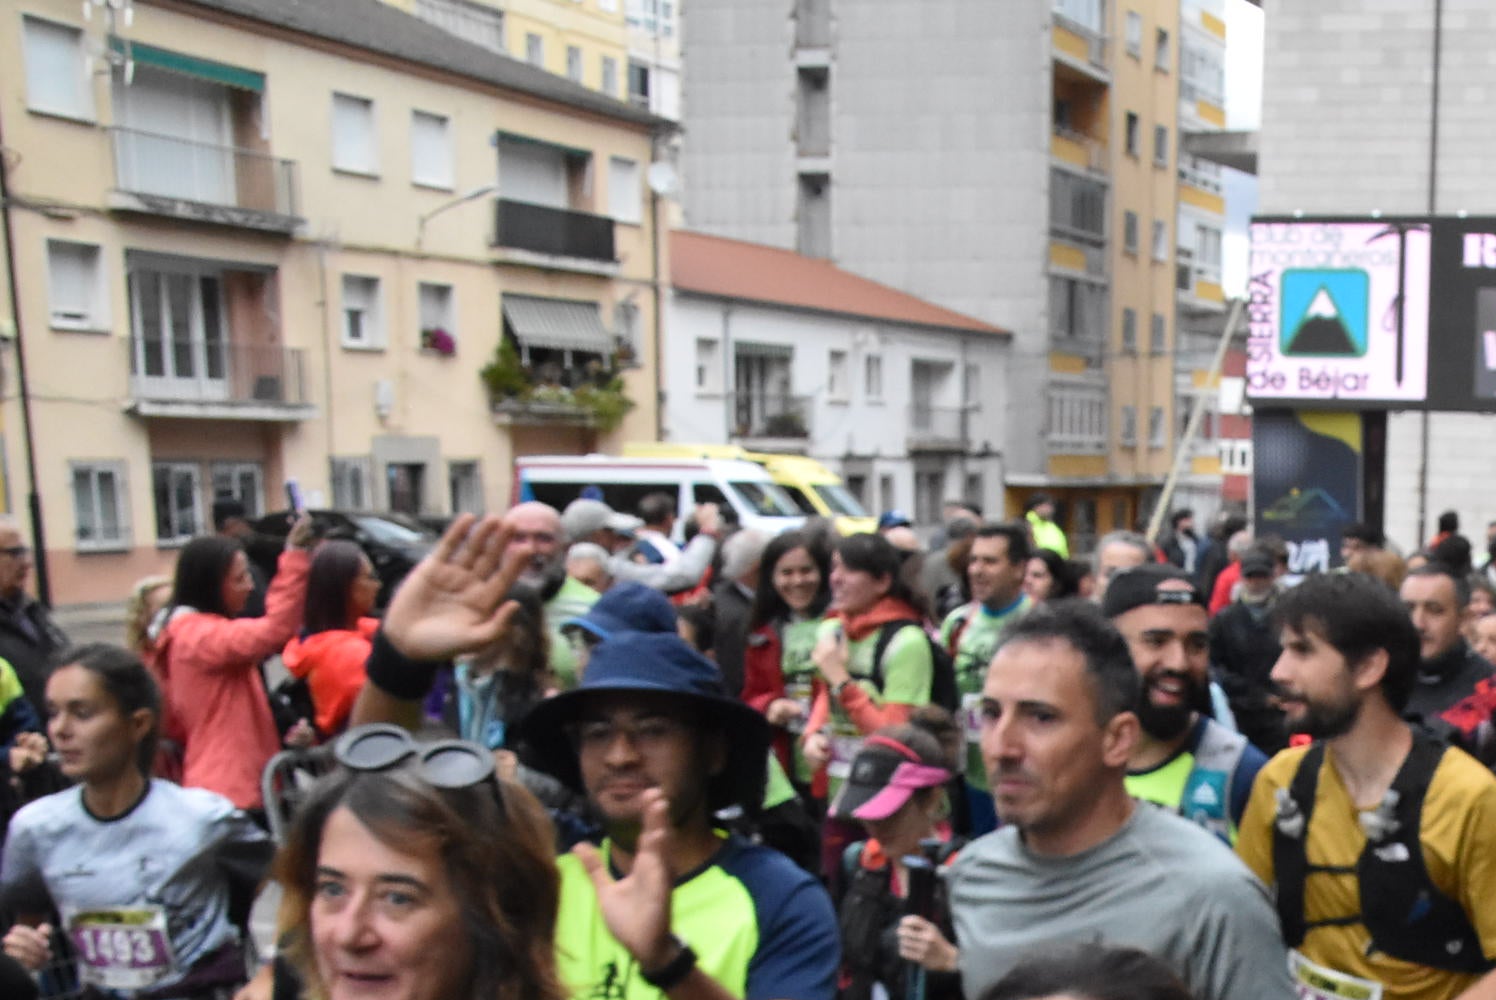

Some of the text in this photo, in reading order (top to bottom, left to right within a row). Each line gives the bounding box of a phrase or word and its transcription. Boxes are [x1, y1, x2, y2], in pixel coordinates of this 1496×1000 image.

[1248, 269, 1274, 362] SIERRA
[1248, 366, 1370, 398] de Béjar
[80, 927, 156, 963] 1493
